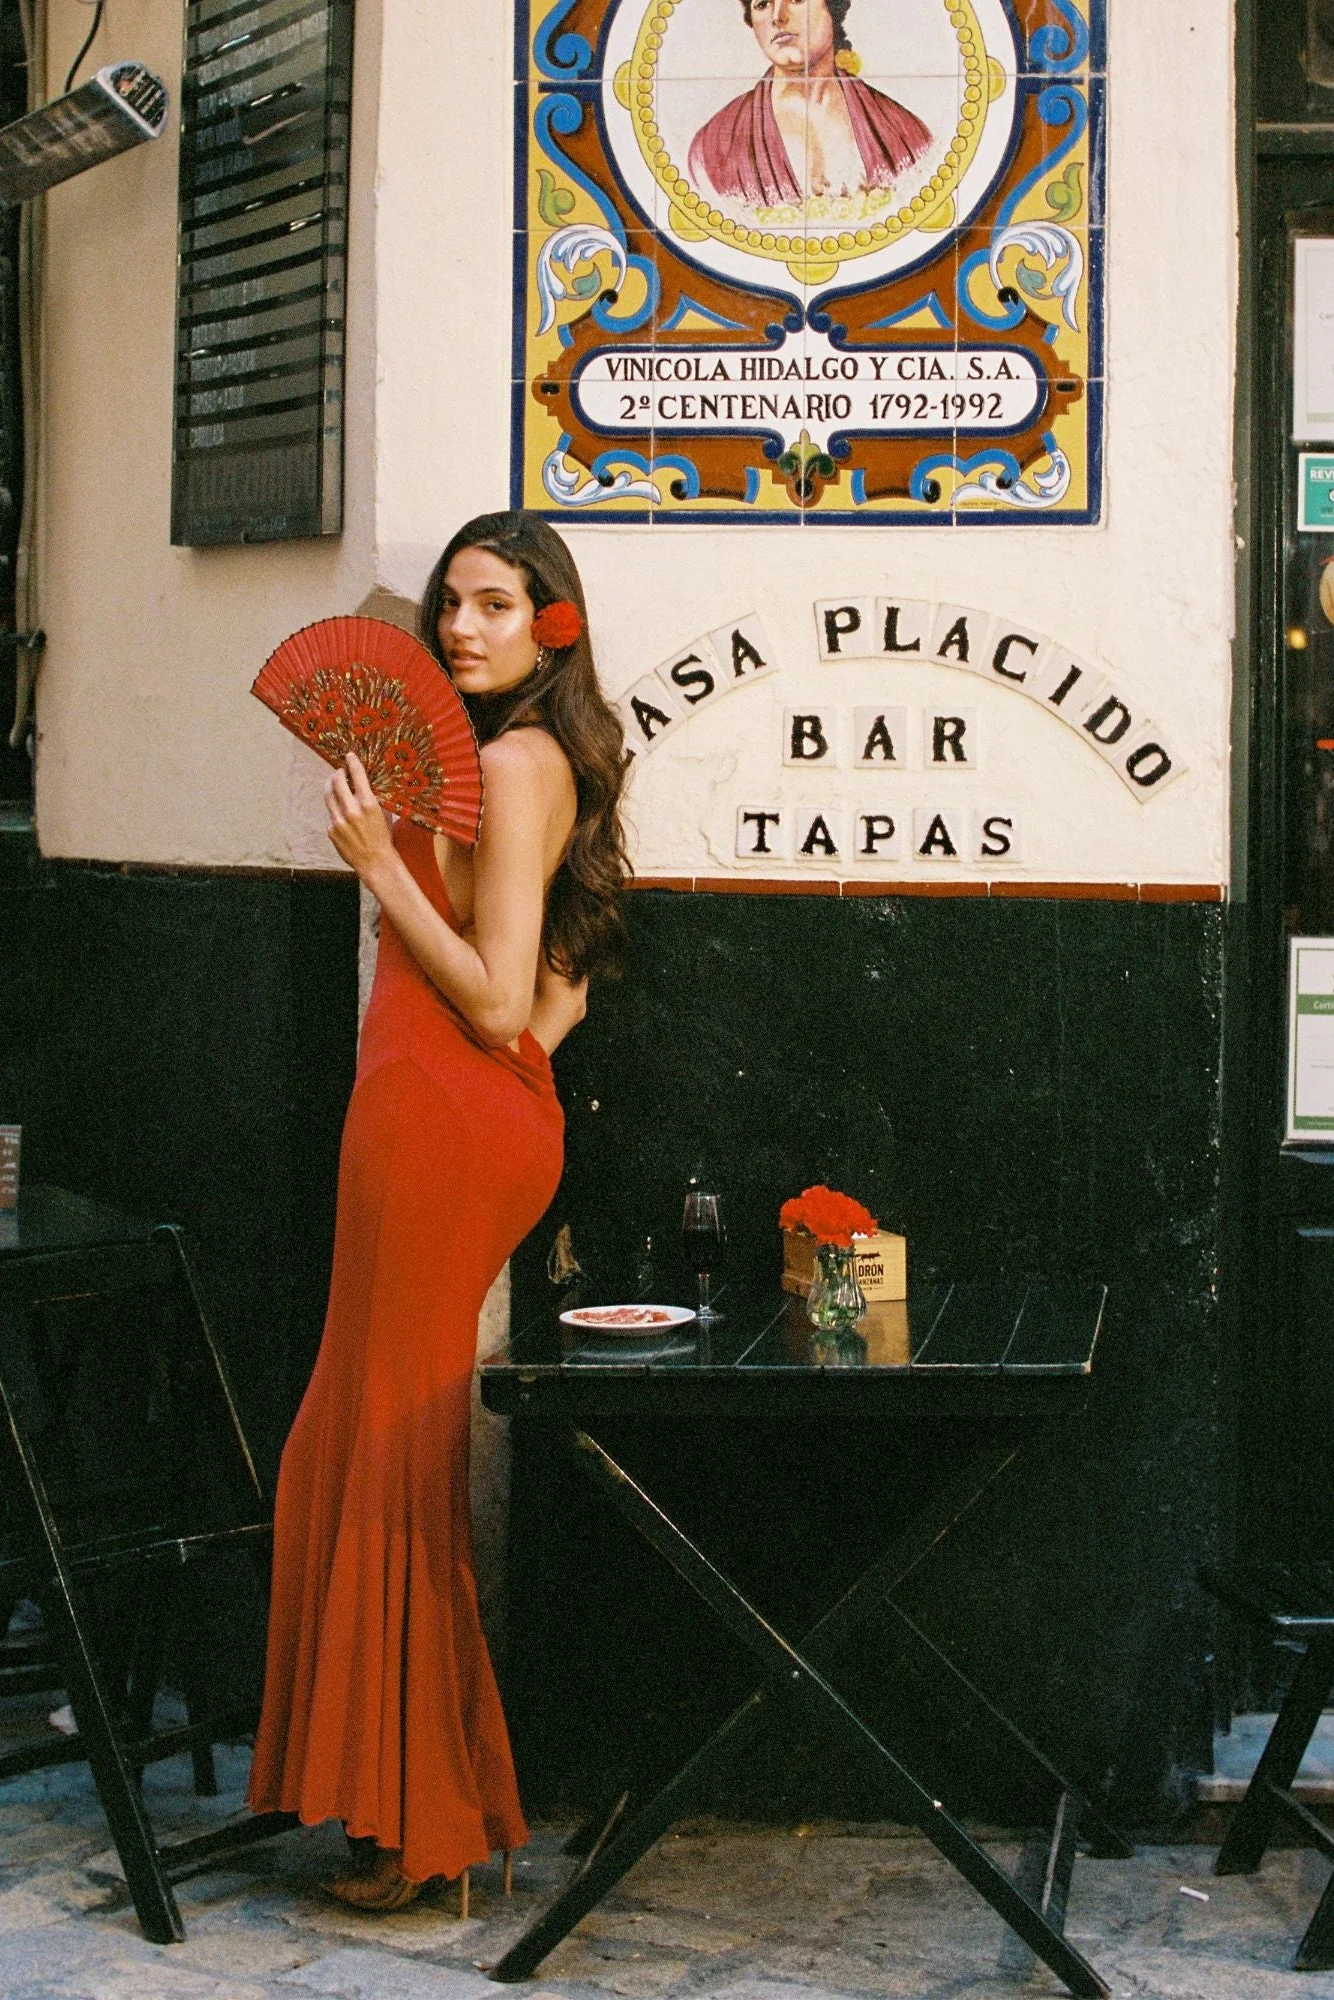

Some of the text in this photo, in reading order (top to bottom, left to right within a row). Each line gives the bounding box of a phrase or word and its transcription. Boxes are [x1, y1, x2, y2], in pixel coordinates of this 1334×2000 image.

[605, 356, 1021, 382] VINICOLA HIDALGO Y CIA. S.A.
[657, 392, 852, 424] CENTENARIO
[869, 392, 1004, 420] 1792-1992
[823, 605, 1172, 788] PLACIDO
[789, 714, 968, 762] BAR
[742, 811, 1014, 857] TAPAS
